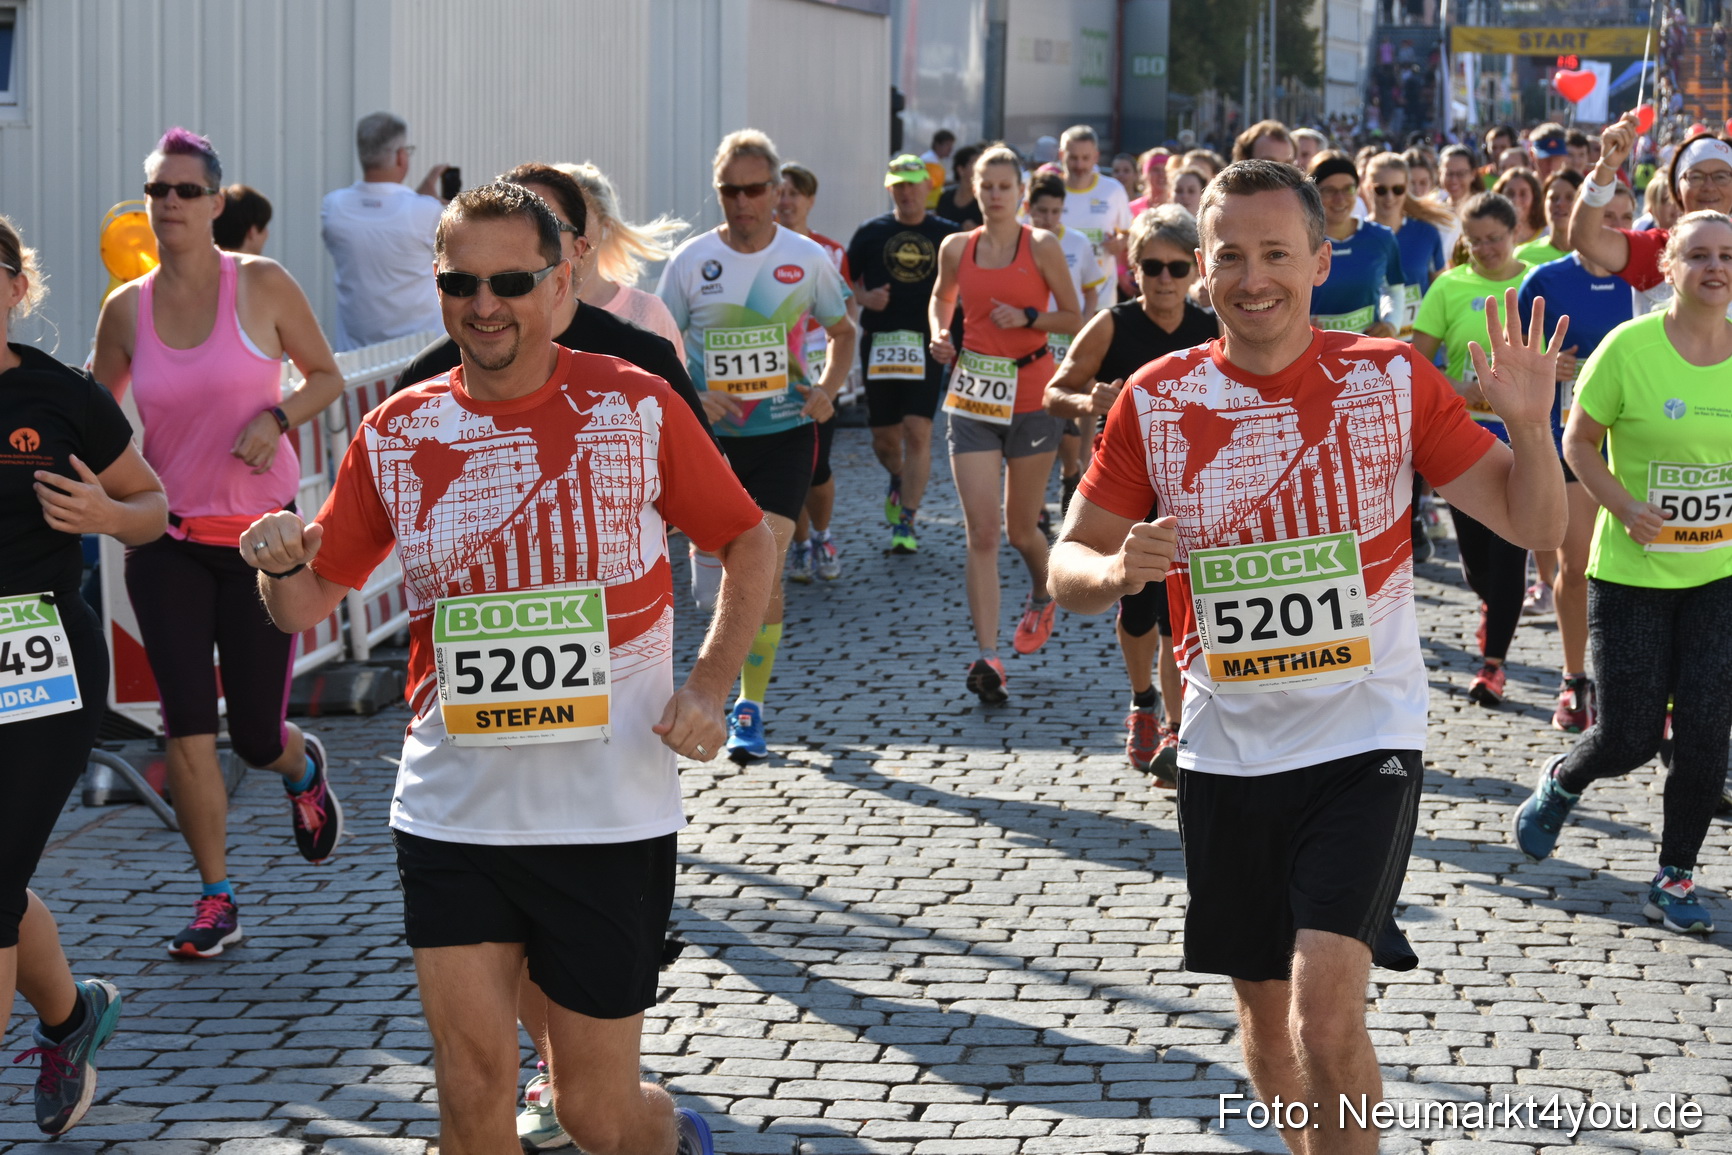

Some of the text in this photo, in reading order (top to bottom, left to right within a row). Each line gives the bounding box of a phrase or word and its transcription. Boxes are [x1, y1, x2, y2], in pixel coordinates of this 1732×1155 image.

[1519, 33, 1590, 50] START
[710, 328, 780, 348] BOCK
[714, 351, 778, 376] 5113
[876, 348, 918, 362] 5236
[961, 352, 1010, 376] BOCK
[728, 380, 768, 392] PETER
[955, 373, 1007, 400] 5270
[1345, 376, 1391, 394] 91.62%
[1225, 396, 1260, 409] 10.54
[590, 414, 640, 427] 91.62%
[458, 424, 494, 440] 10.54
[1227, 455, 1264, 470] 52.01
[1226, 474, 1266, 490] 26.22
[1657, 466, 1732, 487] BOCK
[458, 486, 500, 503] 52.01
[458, 506, 500, 524] 26.22
[1674, 529, 1723, 542] MARIA
[1200, 540, 1347, 588] BOCK
[1350, 588, 1357, 596] S
[445, 594, 592, 636] BOCK
[1214, 588, 1342, 644] 5201
[594, 645, 600, 653] S
[456, 643, 590, 694] 5202
[1223, 646, 1352, 676] MATTHIAS
[0, 686, 50, 708] DRA
[476, 705, 574, 728] STEFAN
[1380, 767, 1408, 776] adidas
